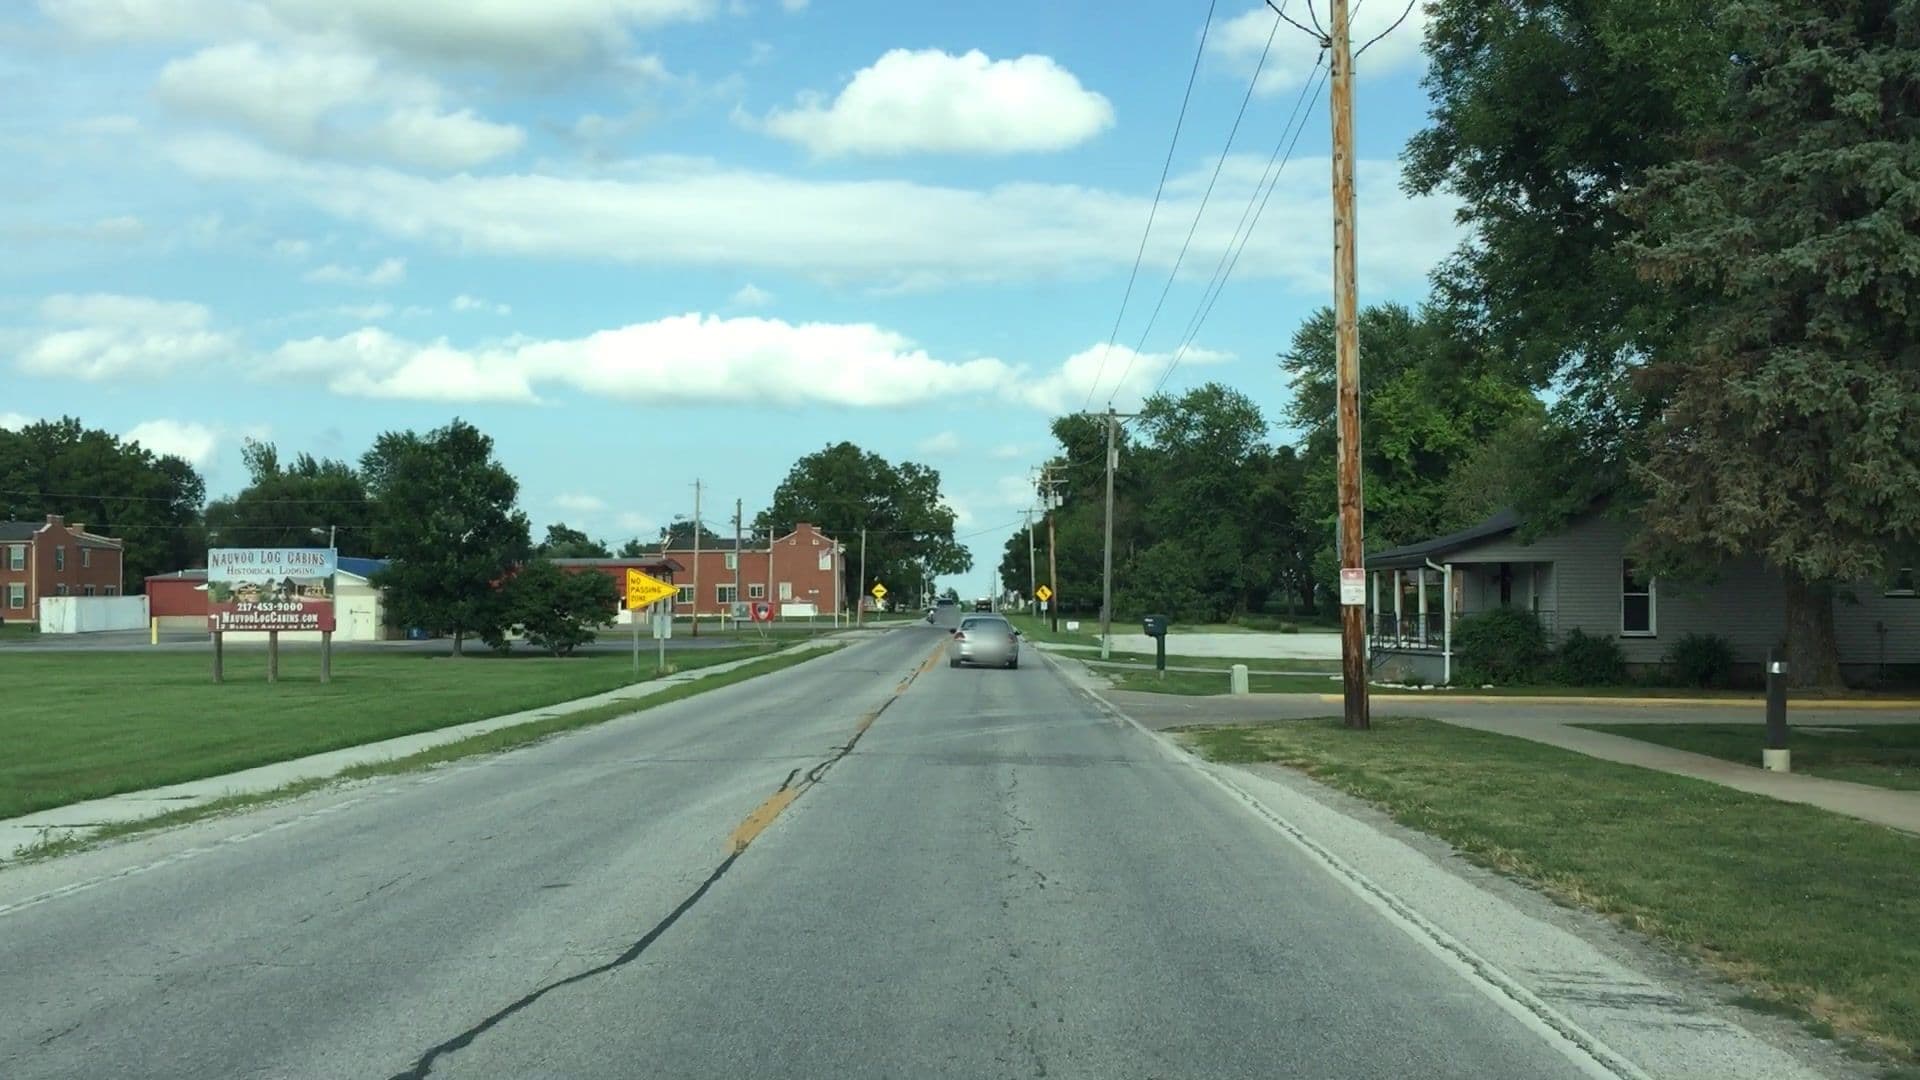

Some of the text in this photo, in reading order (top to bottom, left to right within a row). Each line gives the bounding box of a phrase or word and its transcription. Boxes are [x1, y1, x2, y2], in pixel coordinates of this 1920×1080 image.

[212, 551, 325, 567] NAUVOO LOG CABINS
[227, 567, 315, 575] HISTORICAL LODGING
[630, 577, 641, 585] NO
